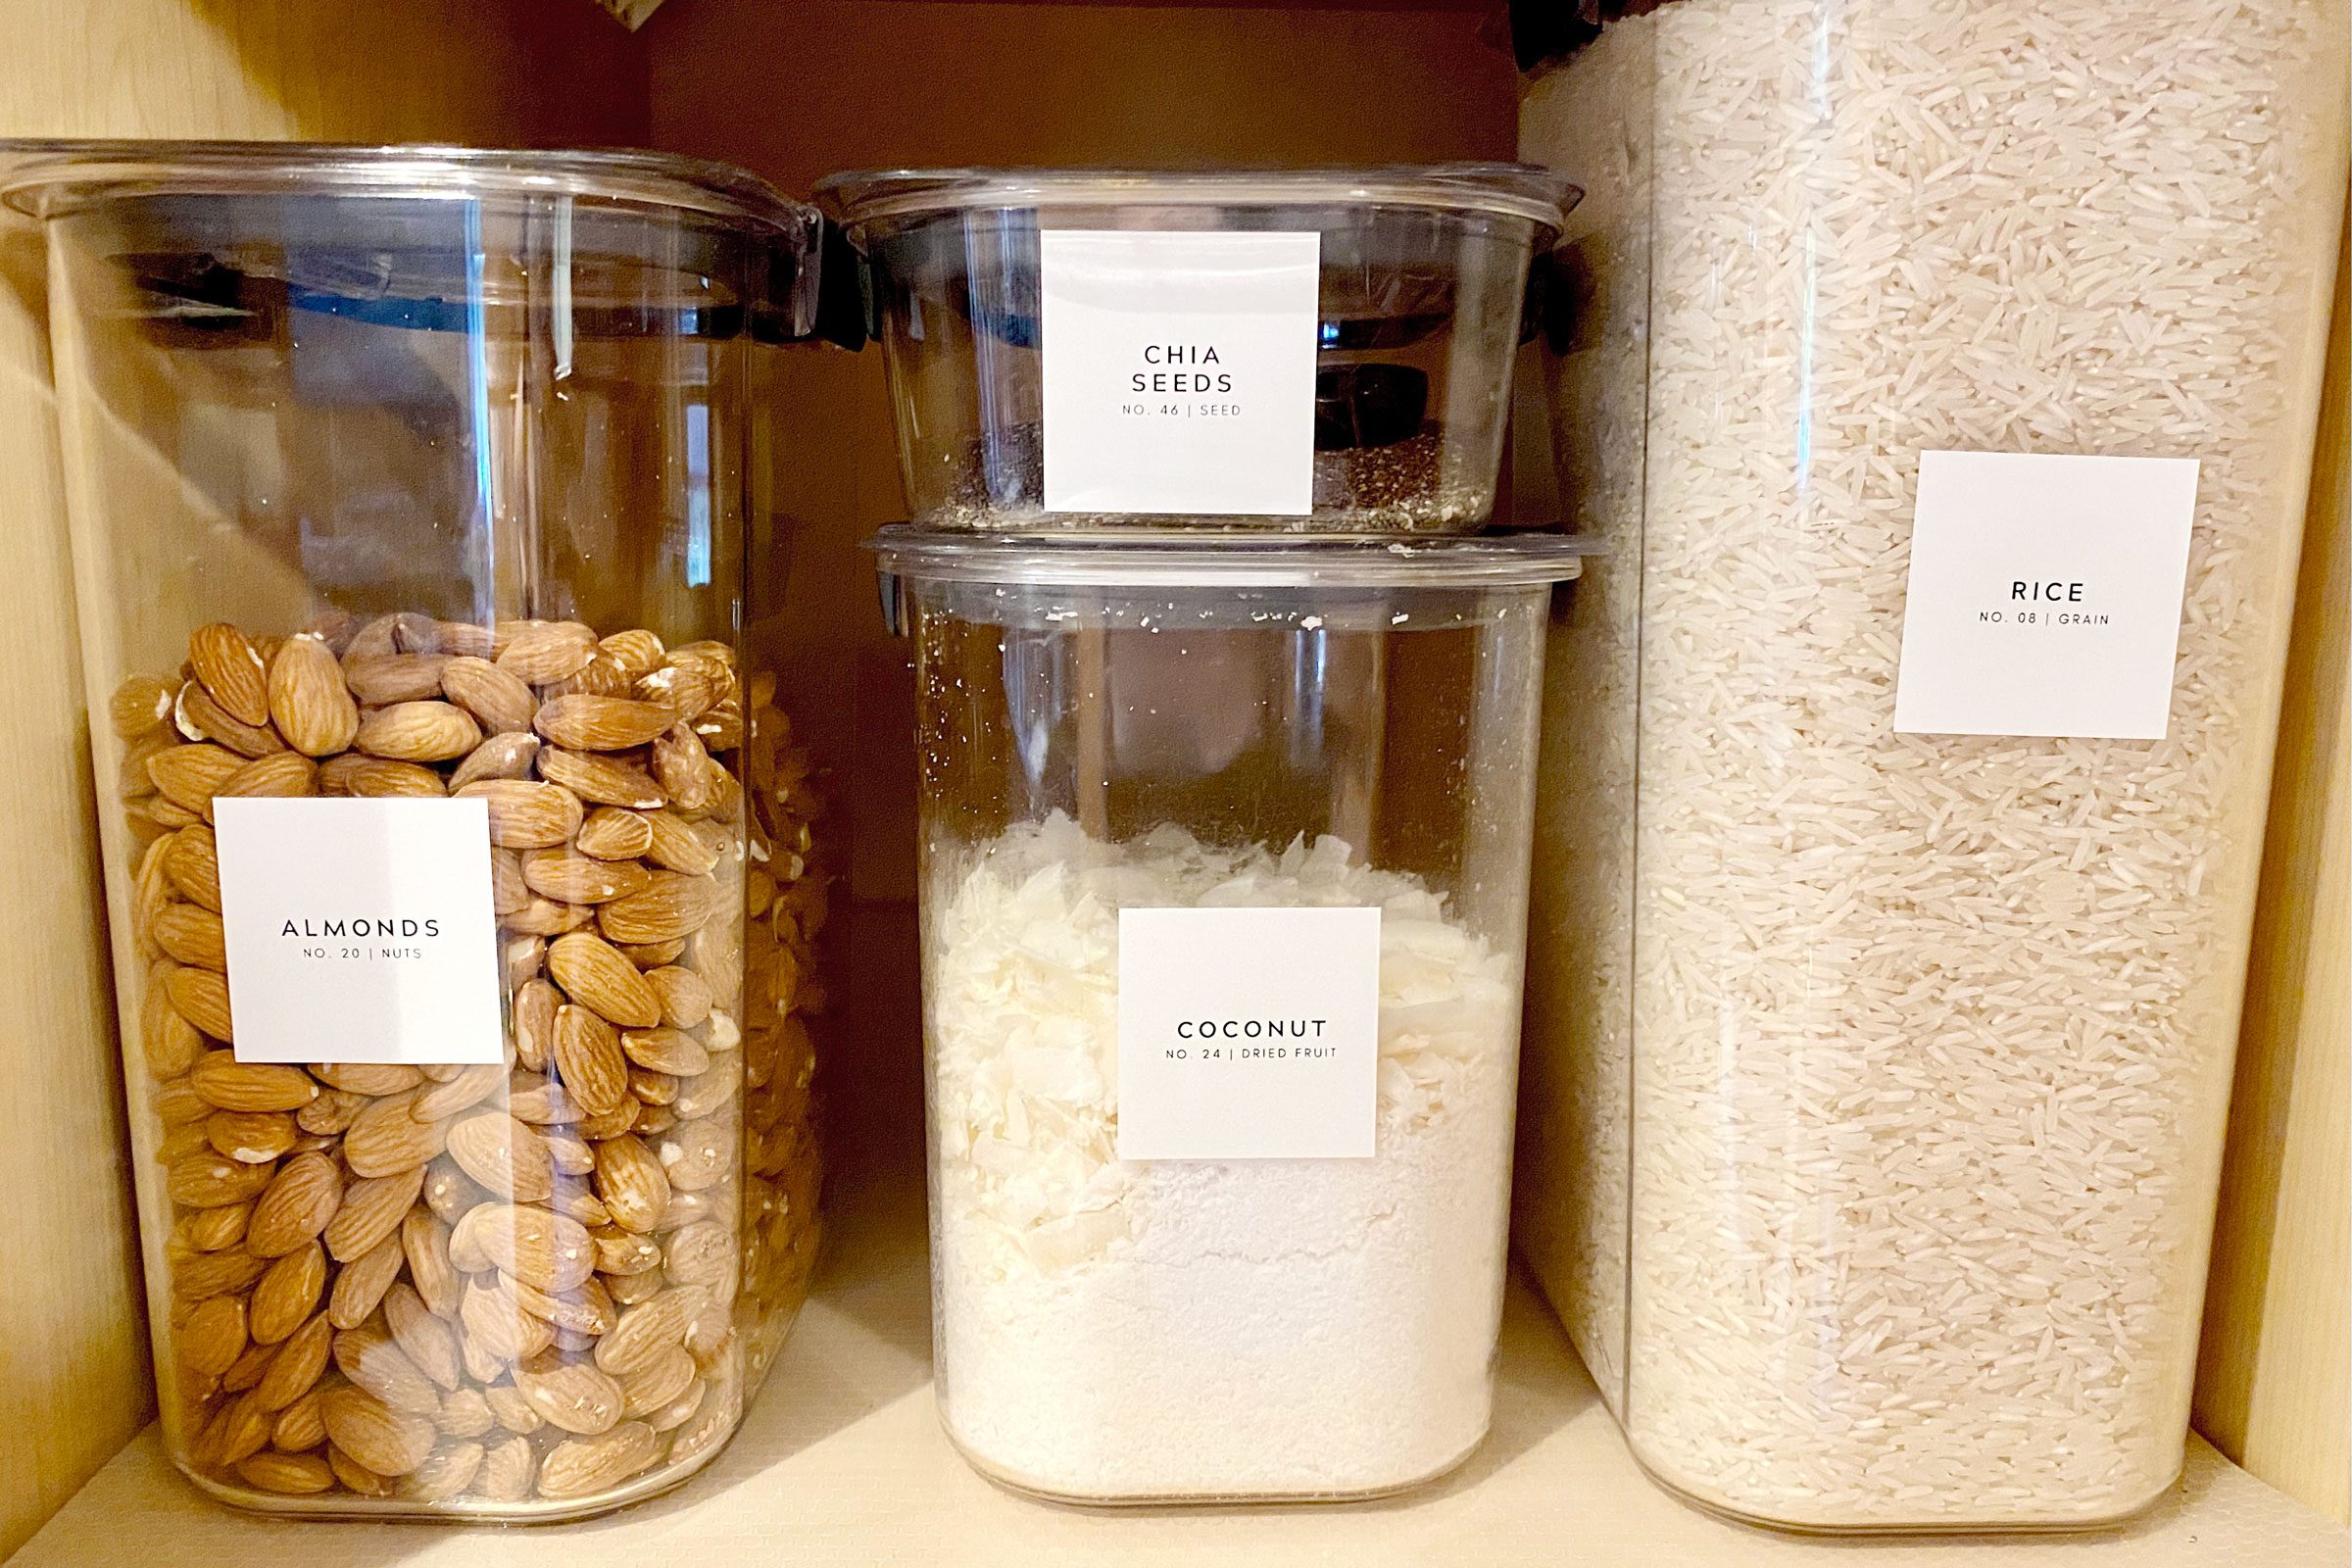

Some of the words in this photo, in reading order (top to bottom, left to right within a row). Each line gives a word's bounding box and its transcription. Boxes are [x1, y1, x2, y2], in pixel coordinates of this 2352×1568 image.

[1144, 345, 1220, 366] CHIA
[1132, 372, 1232, 393] SEEDS
[1122, 404, 1151, 416] NO.
[1159, 404, 1179, 416] 46
[1200, 404, 1241, 416] SEED
[2011, 580, 2084, 603] RICE
[1979, 611, 2008, 624] NO.
[2017, 612, 2036, 624] 08
[2058, 612, 2110, 626] GRAIN
[281, 918, 440, 938] ALMONDS
[303, 947, 332, 959] NO.
[340, 947, 360, 959] 20
[381, 947, 422, 959] NUTS
[1177, 1019, 1327, 1040] COCONUT
[1165, 1048, 1194, 1060] NO.
[1201, 1048, 1221, 1059] 24
[1242, 1048, 1287, 1059] DRIED
[1295, 1047, 1337, 1059] FRUIT
